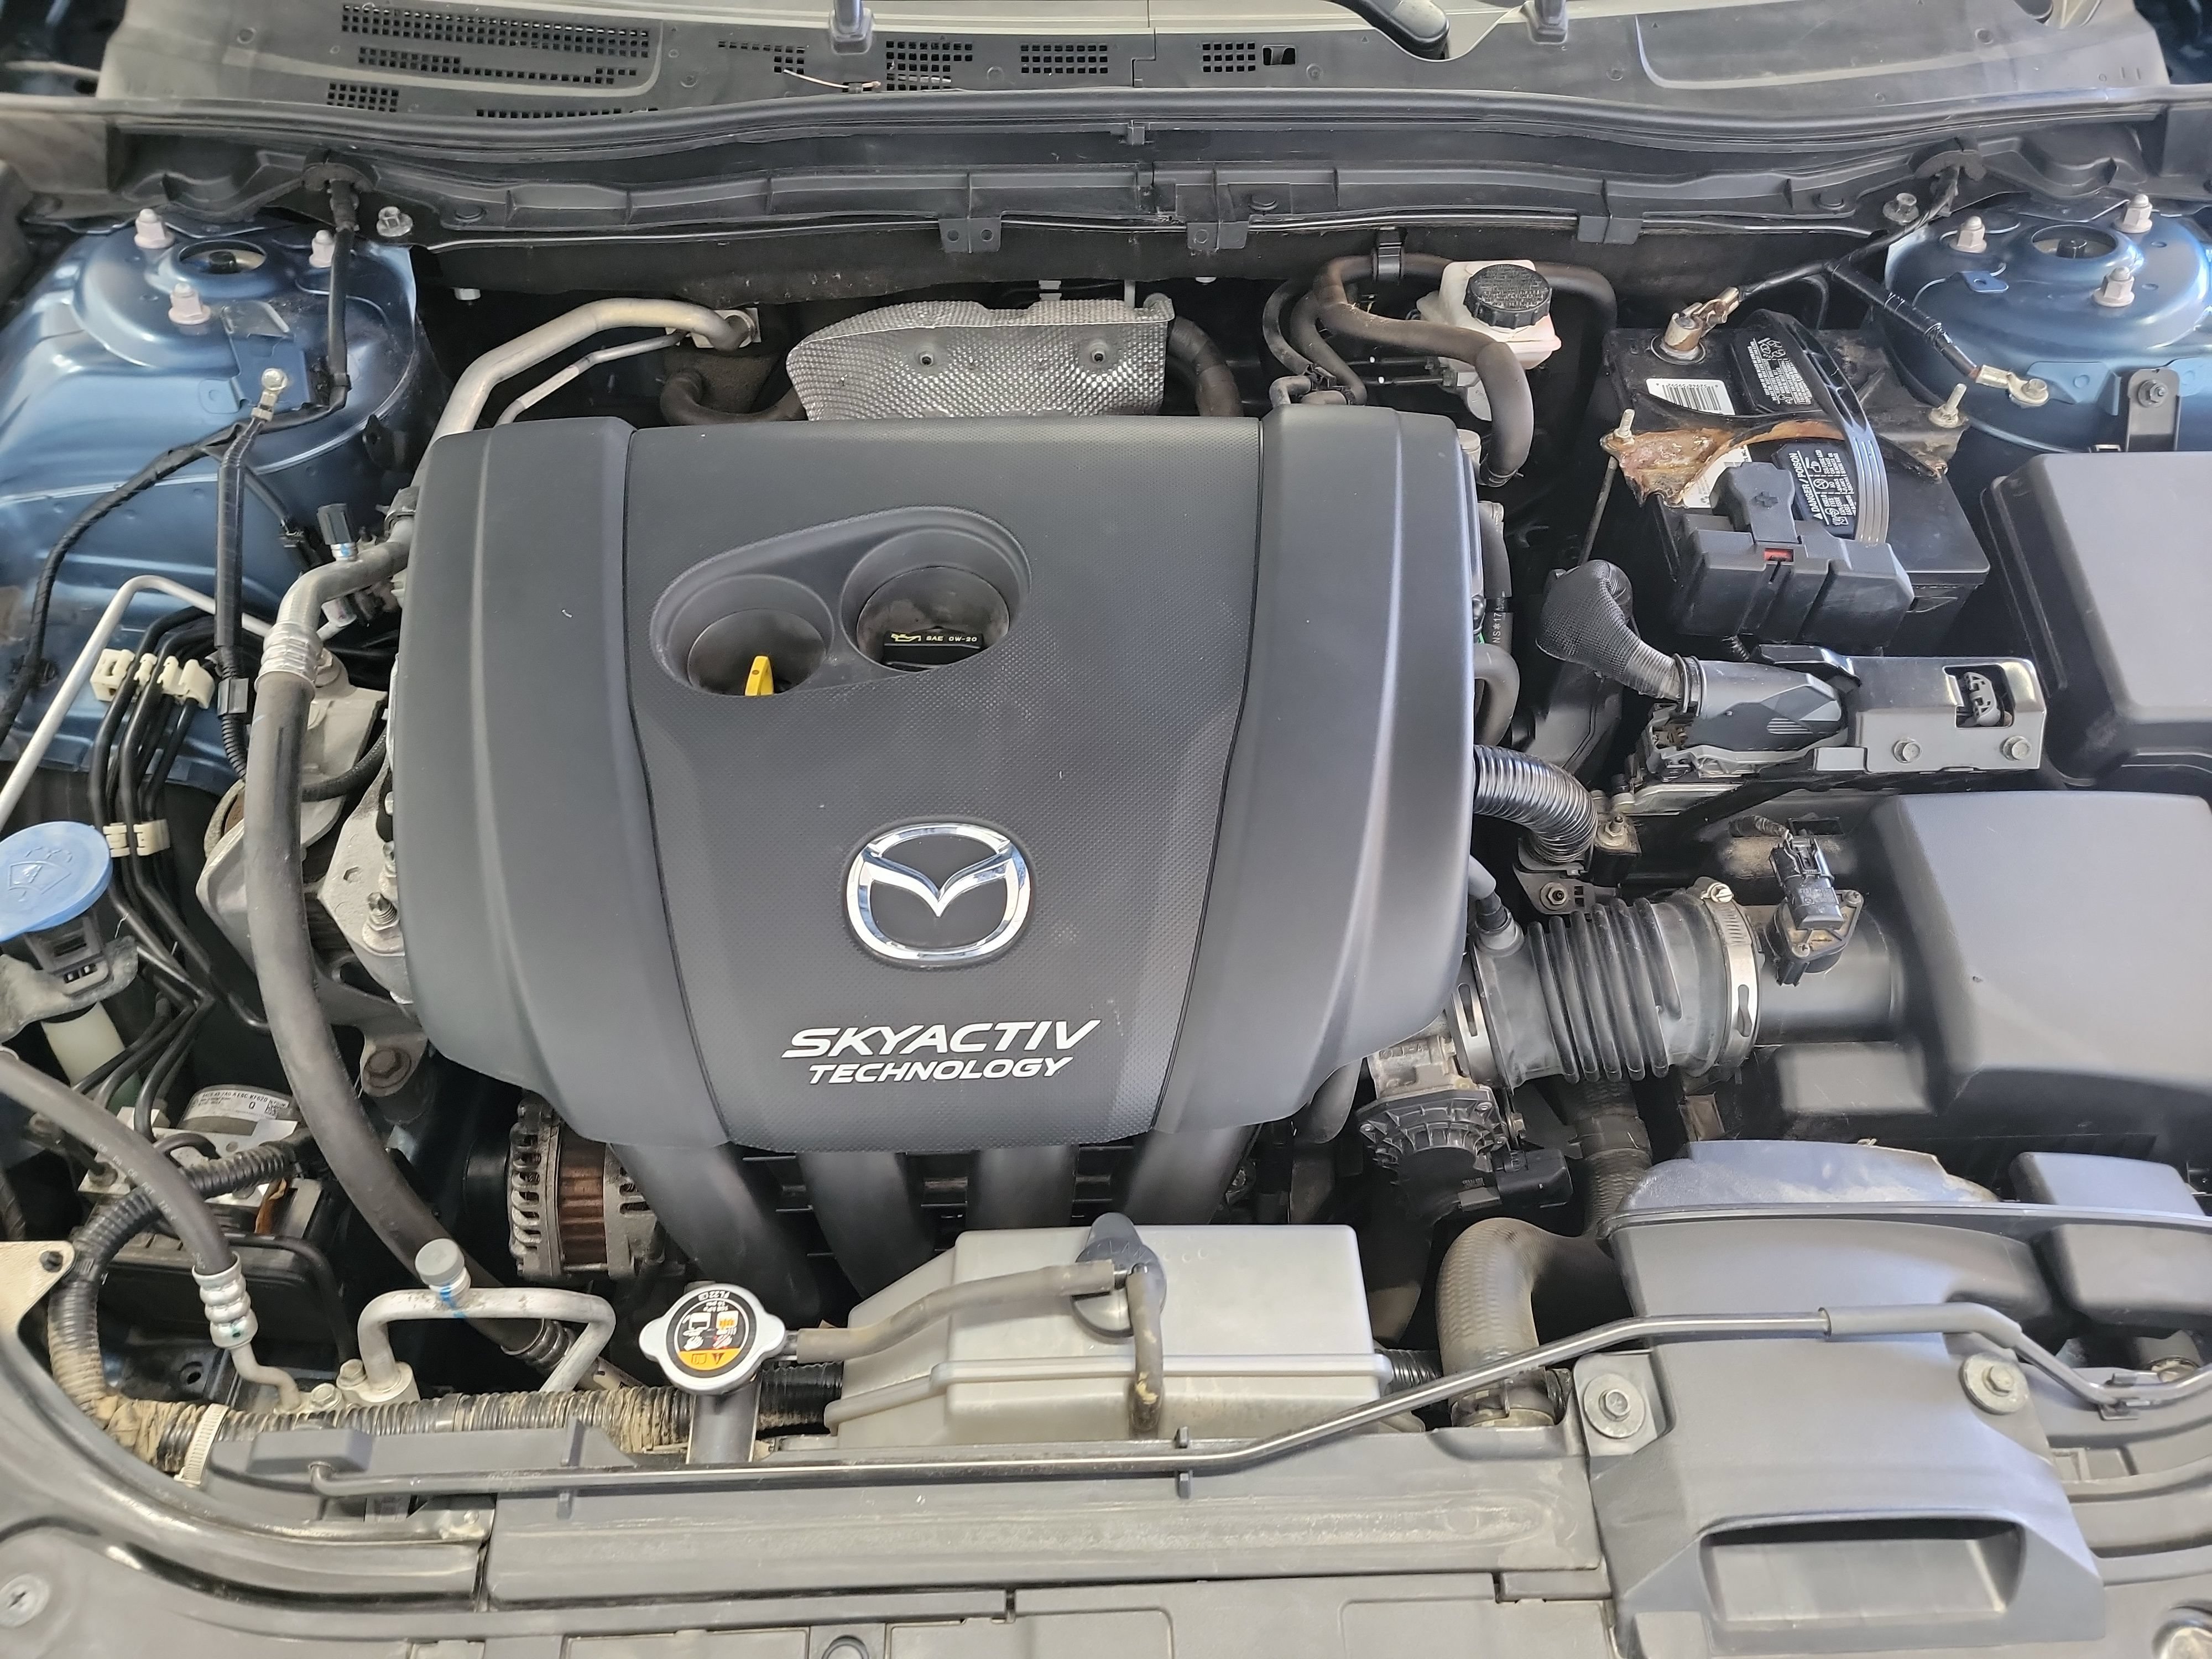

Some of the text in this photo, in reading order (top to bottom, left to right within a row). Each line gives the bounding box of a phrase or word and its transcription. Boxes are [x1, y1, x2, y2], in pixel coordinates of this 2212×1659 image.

[1789, 453, 1806, 477] POISON
[1802, 484, 1820, 512] DANGER
[781, 1019, 1101, 1058] SKYACTIV
[808, 1056, 1074, 1084] TECHNOLOGY
